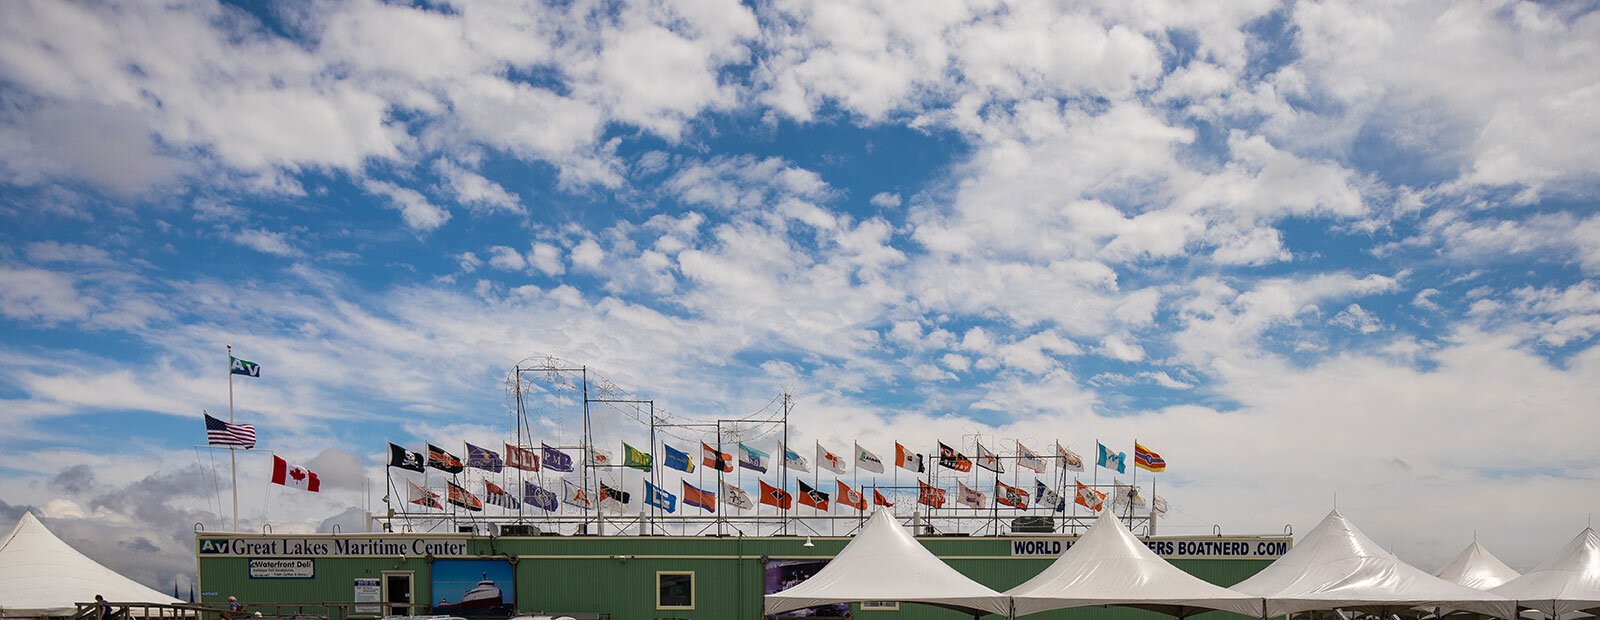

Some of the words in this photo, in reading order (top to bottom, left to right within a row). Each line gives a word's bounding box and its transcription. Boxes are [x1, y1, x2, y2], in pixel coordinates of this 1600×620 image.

[231, 358, 258, 376] AV
[232, 539, 276, 555] Great
[283, 539, 328, 555] Lakes
[334, 539, 407, 555] Maritime
[412, 539, 466, 555] Center
[1014, 541, 1061, 554] WORLD
[1178, 541, 1249, 555] BOATNERD
